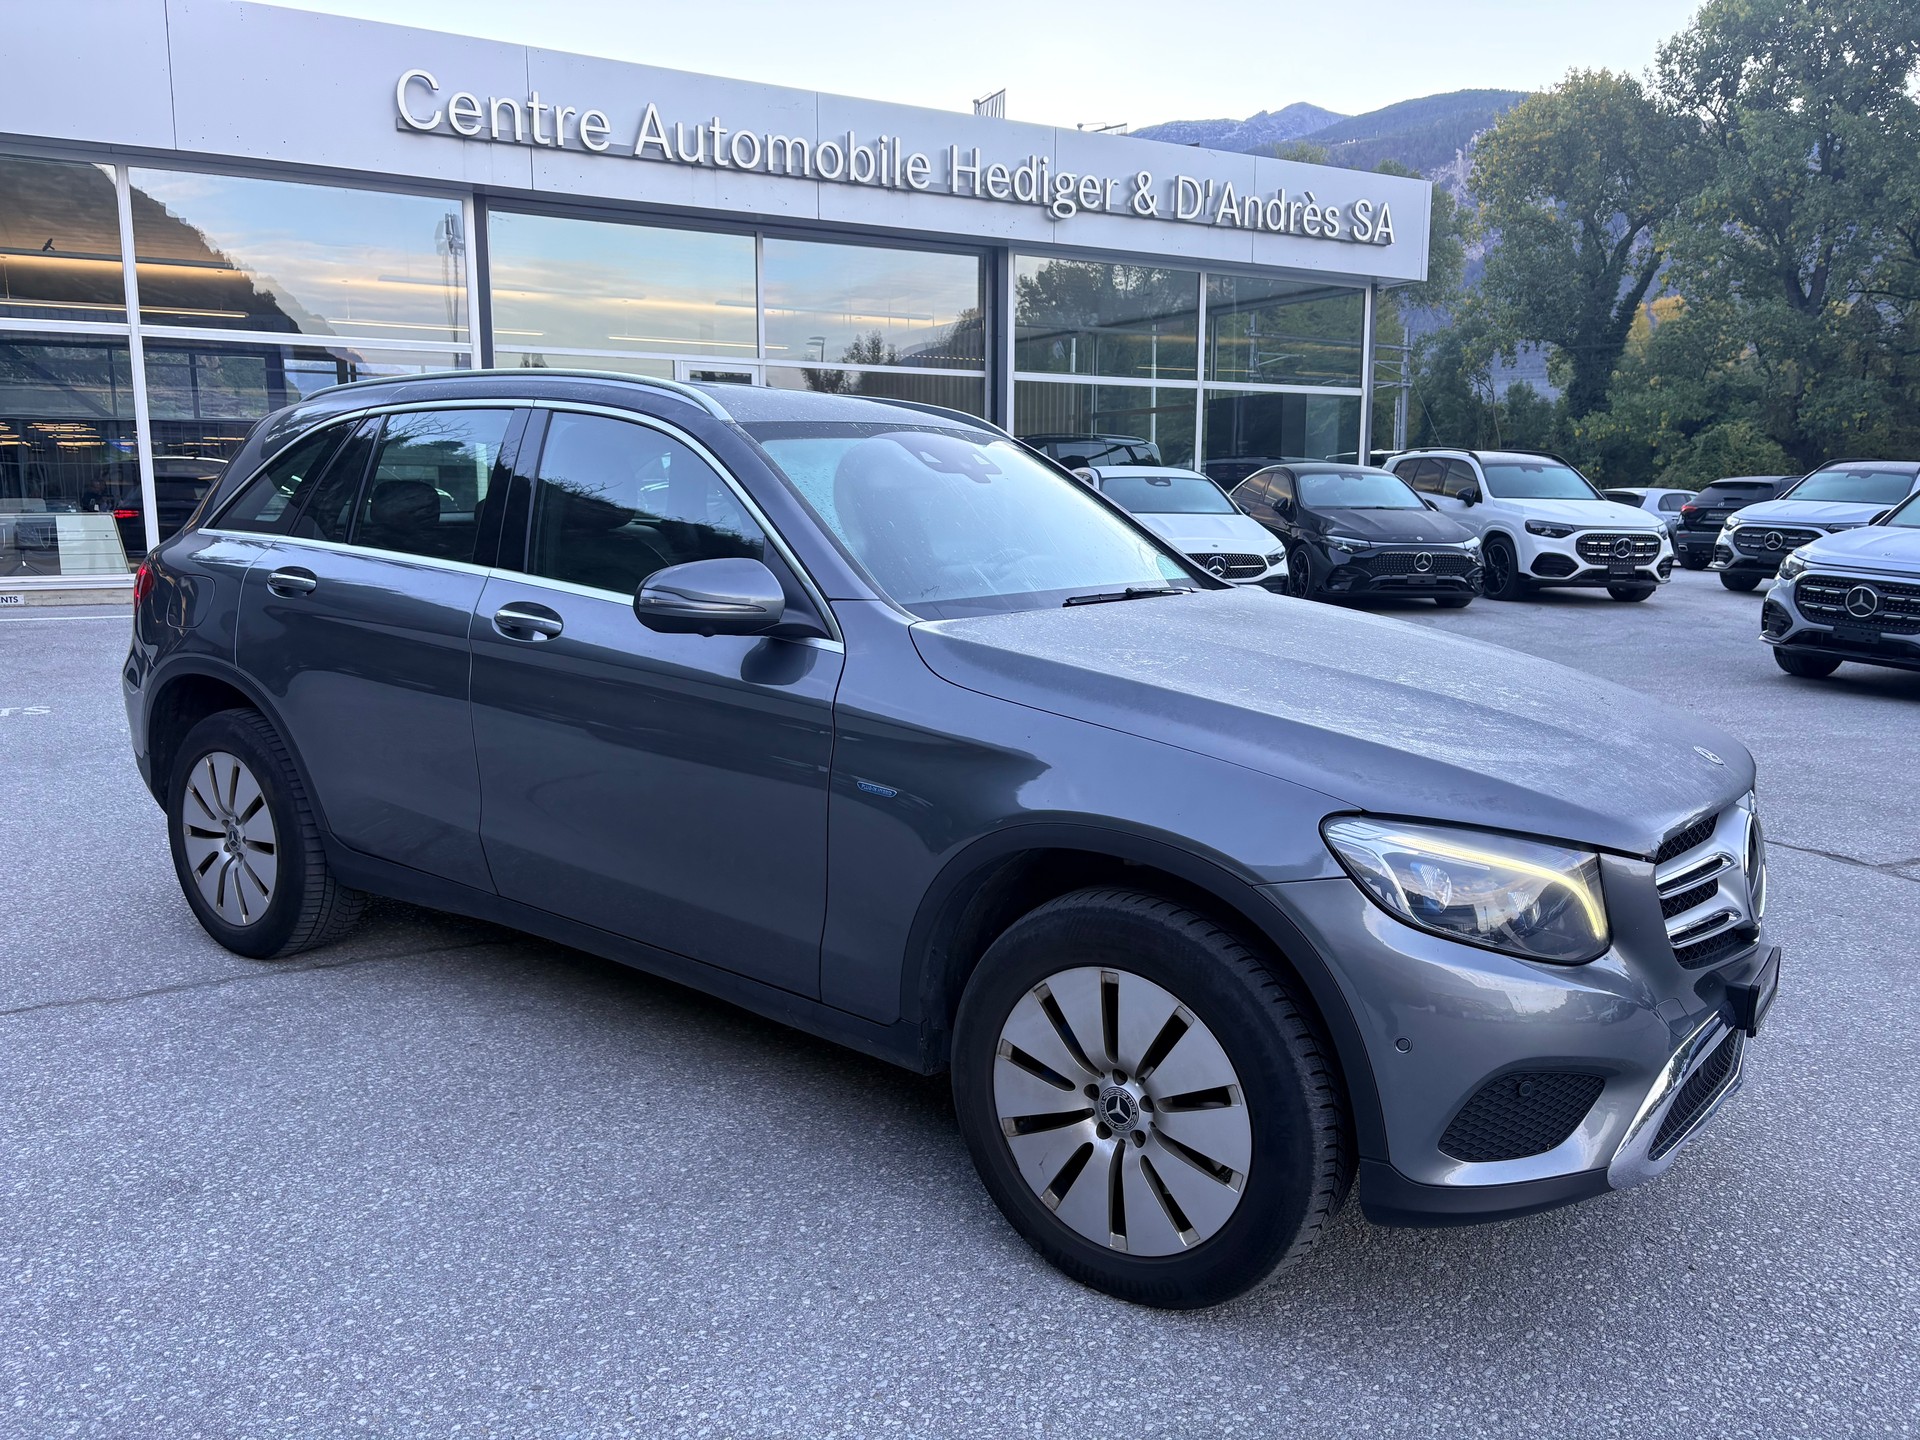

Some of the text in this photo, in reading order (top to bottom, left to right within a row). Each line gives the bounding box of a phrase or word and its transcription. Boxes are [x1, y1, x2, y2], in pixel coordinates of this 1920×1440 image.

[396, 68, 1396, 245] Centre Automobile Hediger & D'Andrès SA
[0, 596, 18, 604] NTS
